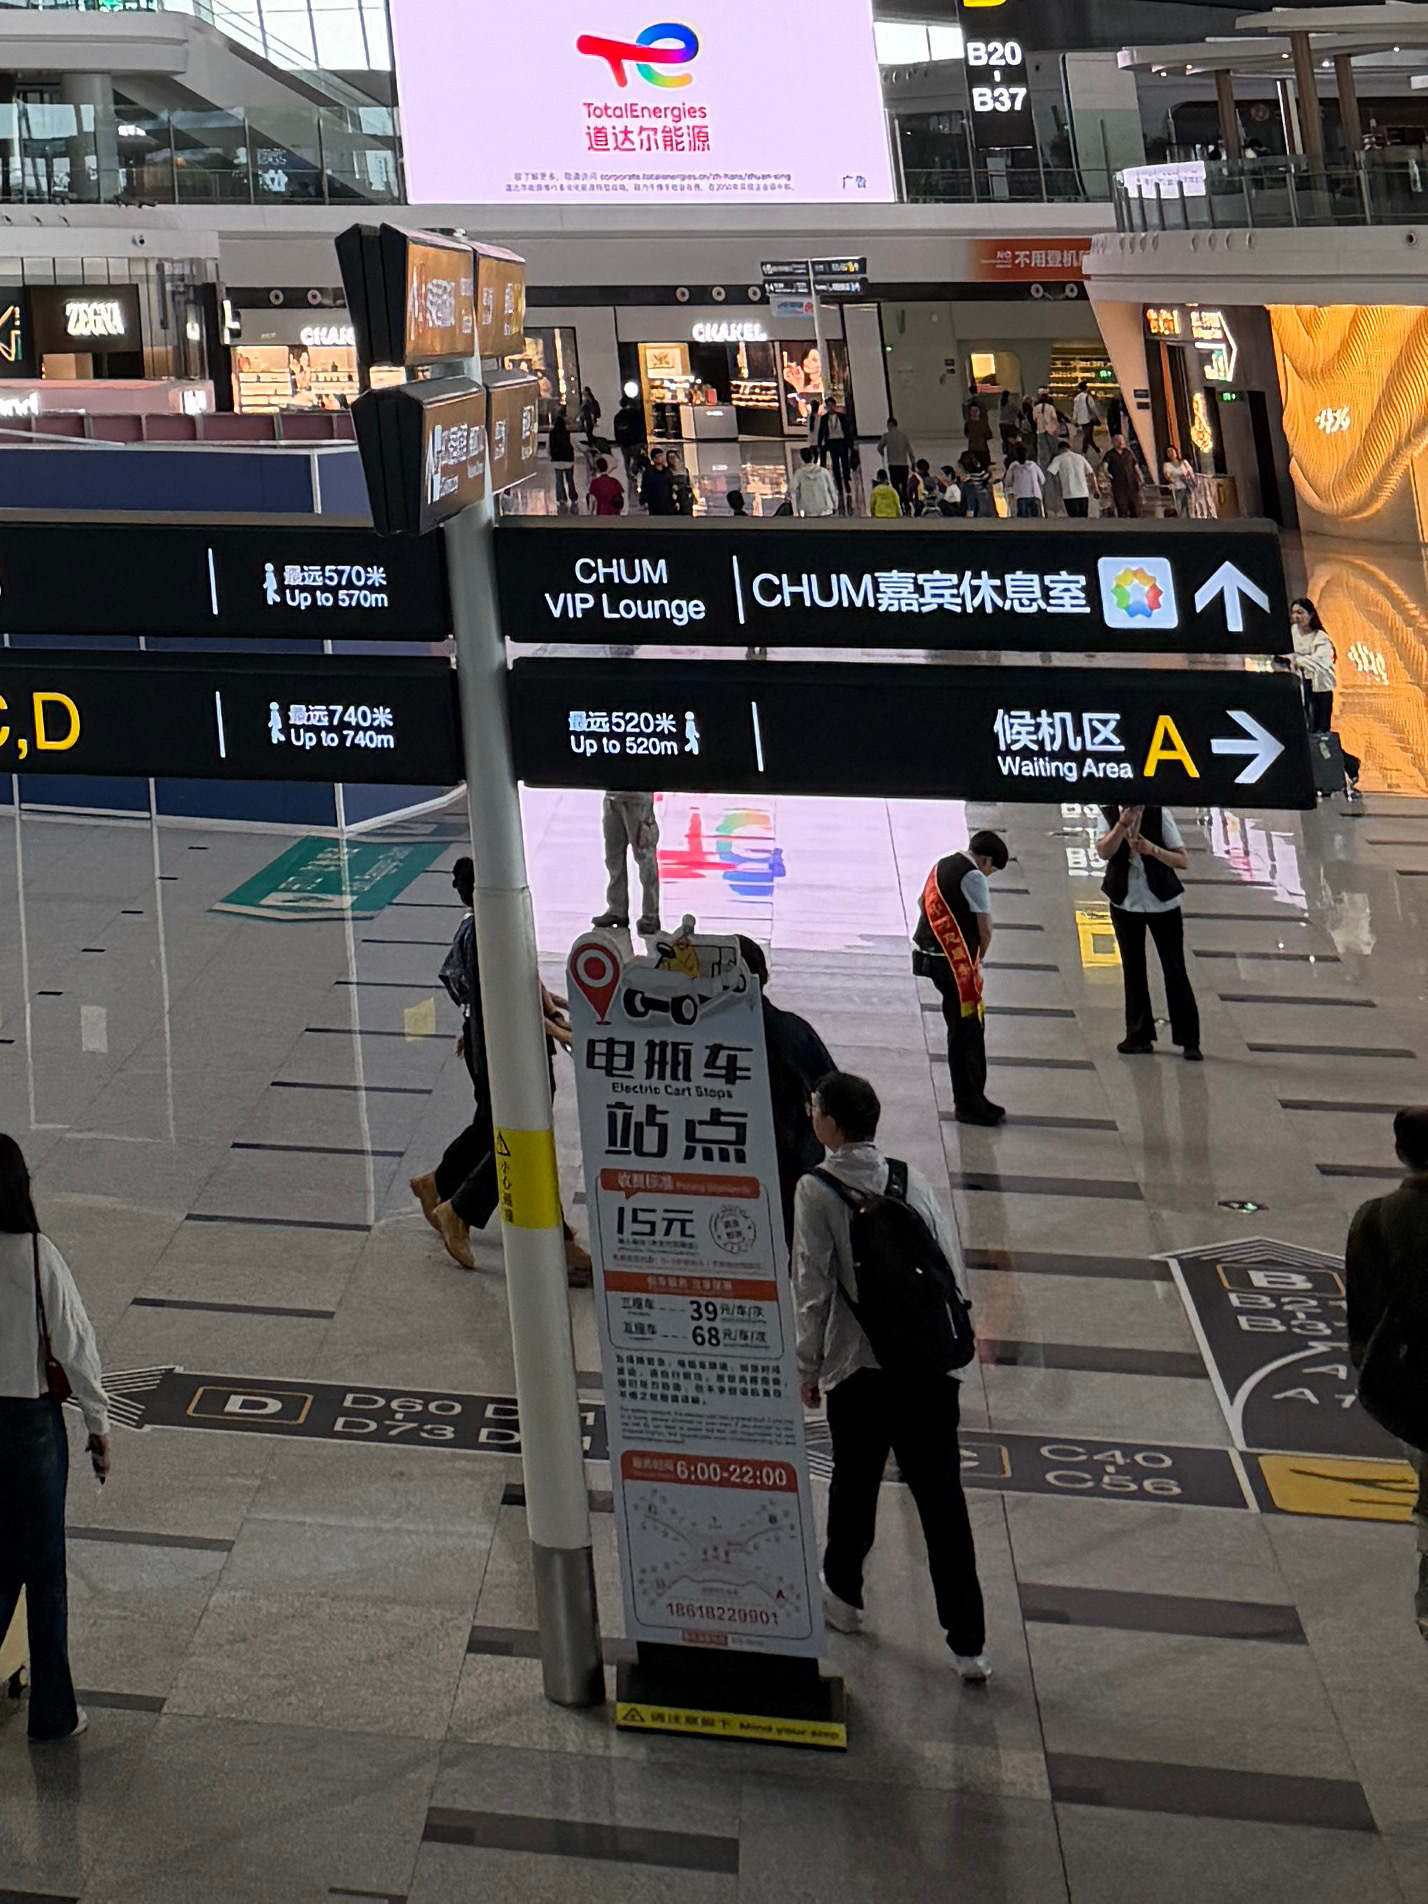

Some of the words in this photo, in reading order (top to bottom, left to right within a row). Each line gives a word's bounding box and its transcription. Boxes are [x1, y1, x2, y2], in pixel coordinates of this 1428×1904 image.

[967, 42, 1022, 66] B20
[972, 88, 1027, 111] B37
[583, 102, 707, 123] TotalEnergies
[586, 125, 710, 152] 道达尔能源
[692, 322, 768, 342] CHANEL
[284, 565, 387, 587] 最远570米
[575, 558, 668, 585] CHUM
[286, 590, 311, 610] Up
[315, 590, 333, 606] to
[338, 591, 388, 607] 570m
[752, 570, 1090, 614] CHUM嘉宾休息室
[544, 593, 597, 619] VIP
[603, 593, 706, 626] Lounge
[289, 705, 393, 727] 最远740米
[569, 710, 677, 735] 最远520米
[290, 729, 315, 748] Up
[320, 730, 338, 746] to
[343, 731, 394, 748] 740m
[570, 736, 596, 756] Up
[601, 737, 621, 753] to
[625, 737, 678, 755] 520m
[994, 708, 1126, 752] 候机区
[1144, 715, 1200, 778] A
[997, 756, 1077, 782] Waiting
[1083, 758, 1134, 779] Area
[586, 1037, 753, 1085] 电瓶车
[612, 1082, 660, 1095] Electric
[664, 1084, 692, 1097] Cart
[695, 1086, 734, 1100] Stops
[605, 1101, 748, 1164] 站点
[617, 1206, 696, 1238] 15元
[1248, 1270, 1313, 1290] B
[689, 1300, 718, 1322] 39
[692, 1325, 721, 1347] 68
[224, 1395, 283, 1416] D
[343, 1393, 463, 1417] D60
[333, 1417, 455, 1441] D73
[1040, 1444, 1173, 1469] C40
[676, 1460, 787, 1486] 6:00-22:00
[1045, 1469, 1182, 1496] C56
